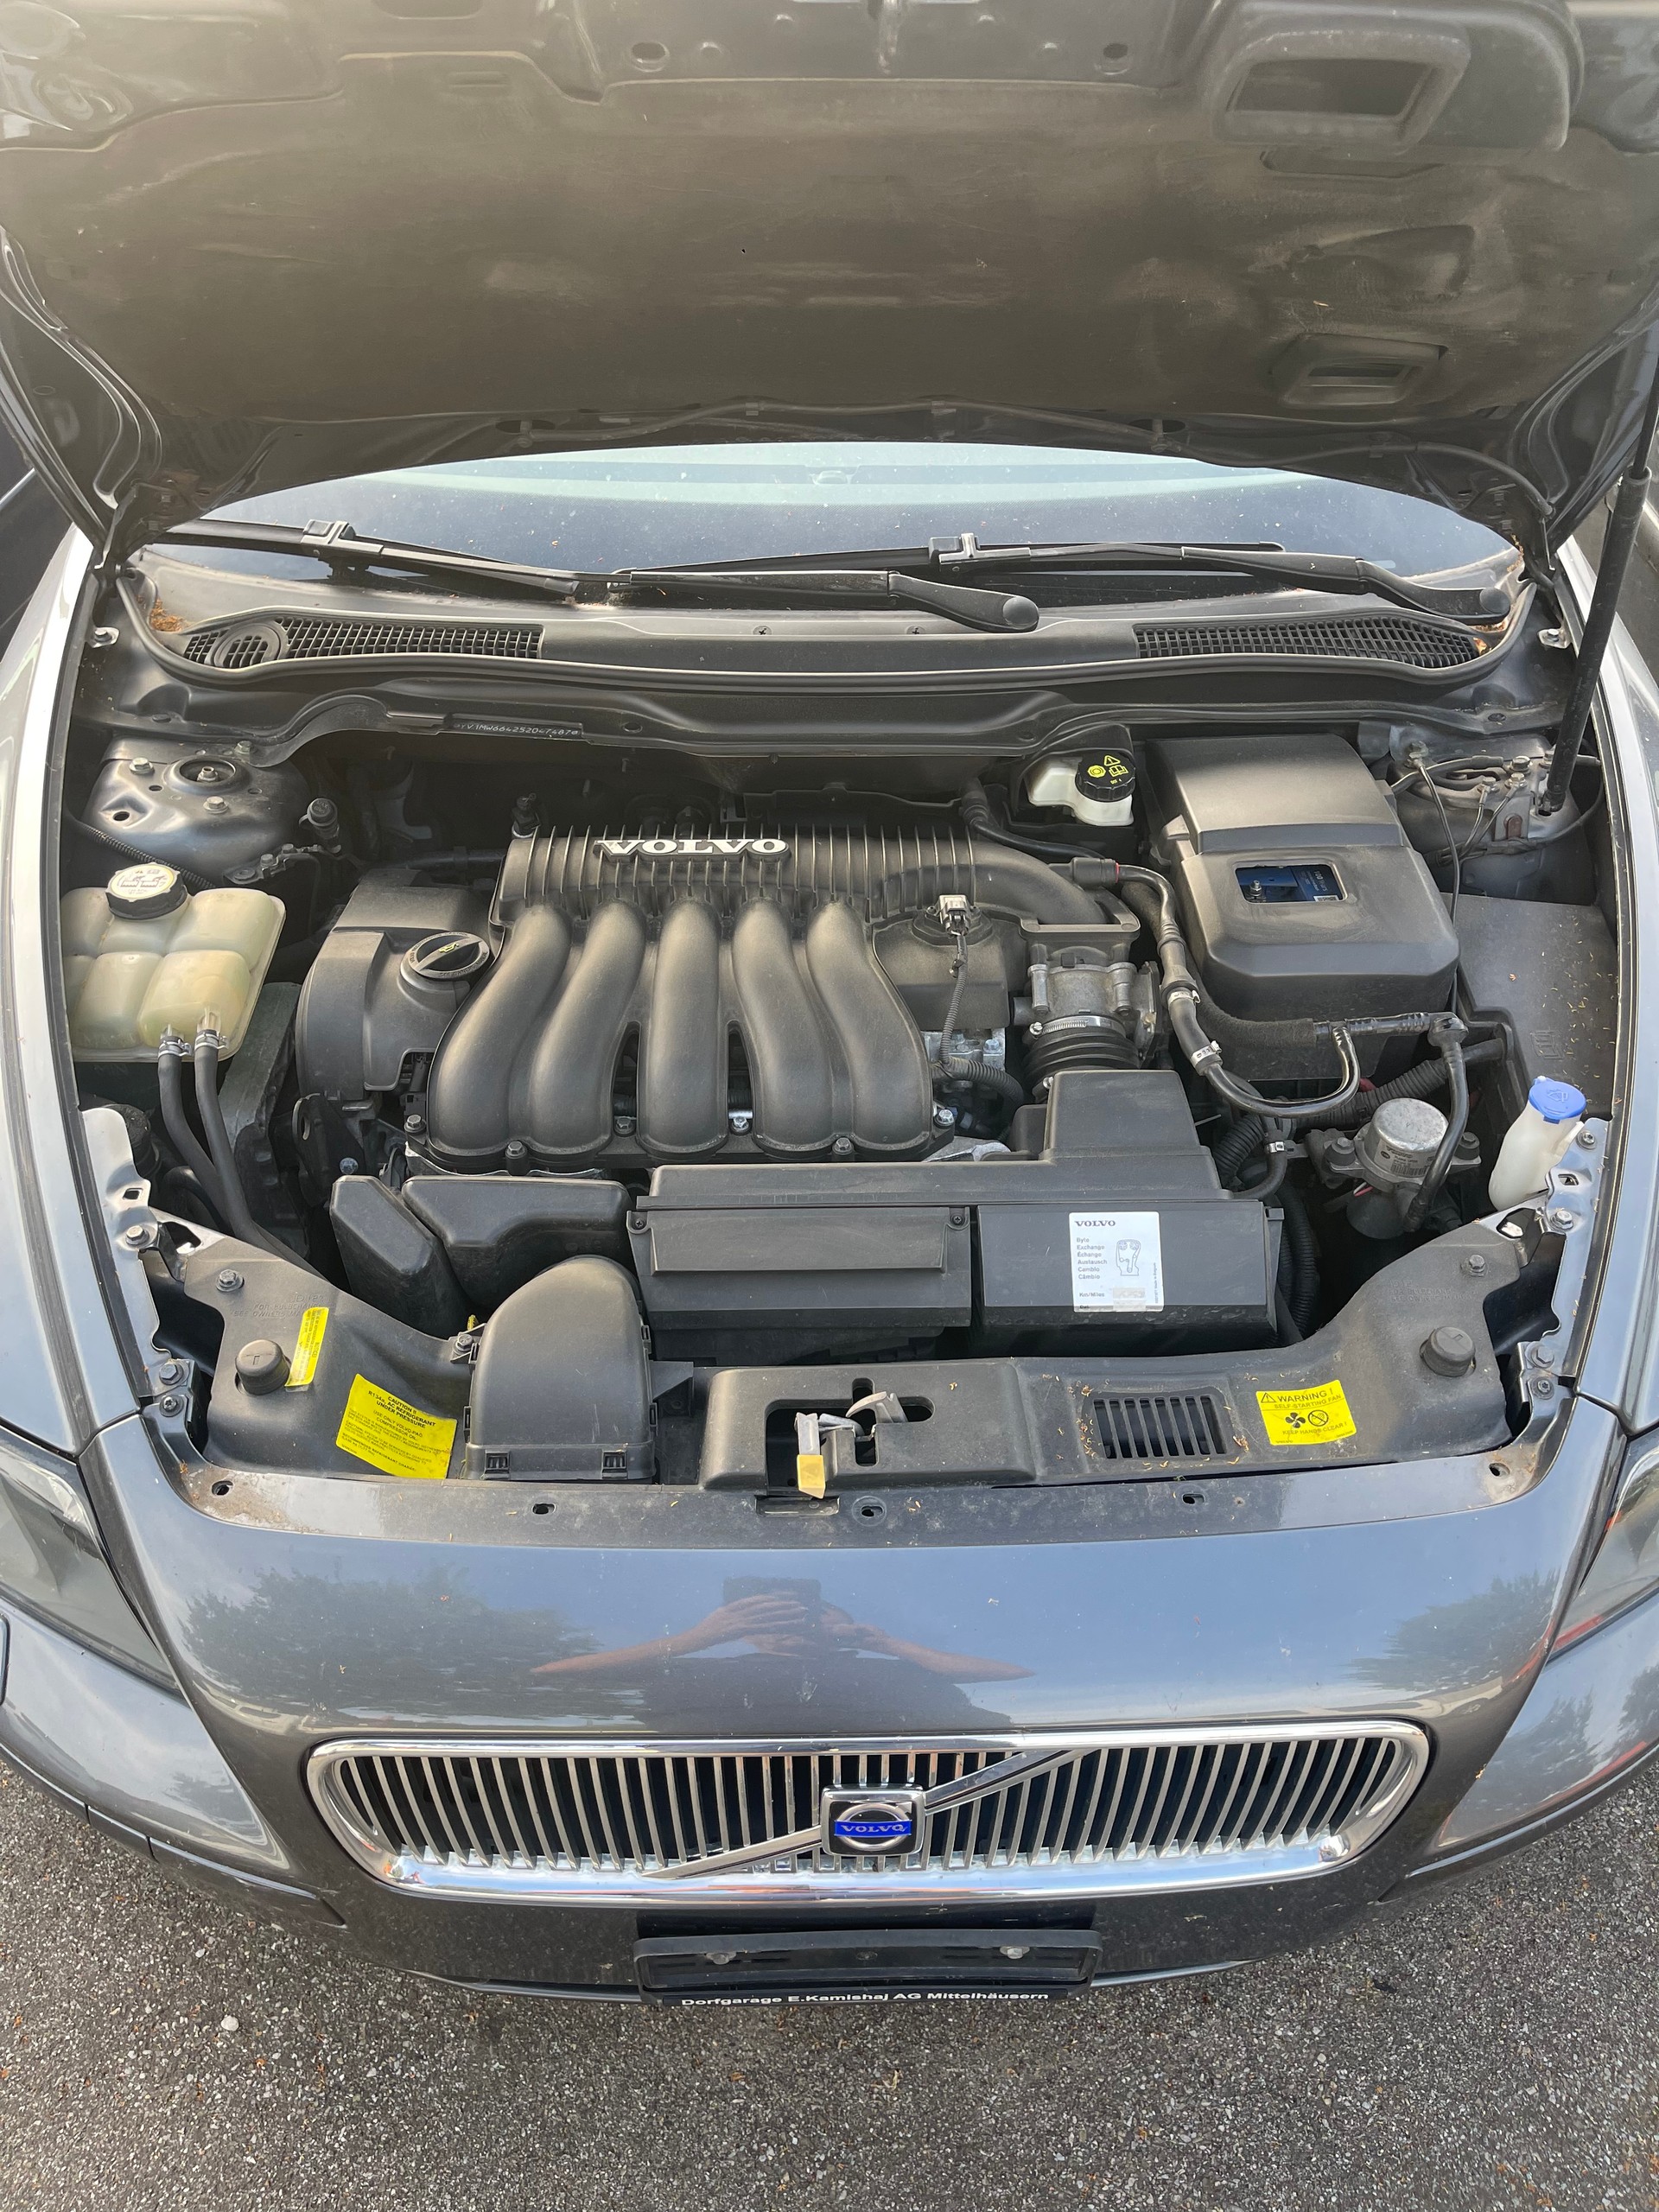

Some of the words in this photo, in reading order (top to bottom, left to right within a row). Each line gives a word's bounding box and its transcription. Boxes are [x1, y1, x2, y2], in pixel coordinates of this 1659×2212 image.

[596, 839, 786, 854] VOLVO
[1277, 1390, 1327, 1402] WARNING
[387, 1396, 412, 1412] CAUTION
[1274, 1400, 1327, 1409] SELF-STARTING
[375, 1401, 395, 1413] UNDER
[395, 1411, 426, 1428] PRESSURE
[1323, 1424, 1344, 1432] CLEAR
[841, 1824, 905, 1832] VOLVO
[788, 1993, 889, 2002] E.Kamishaj
